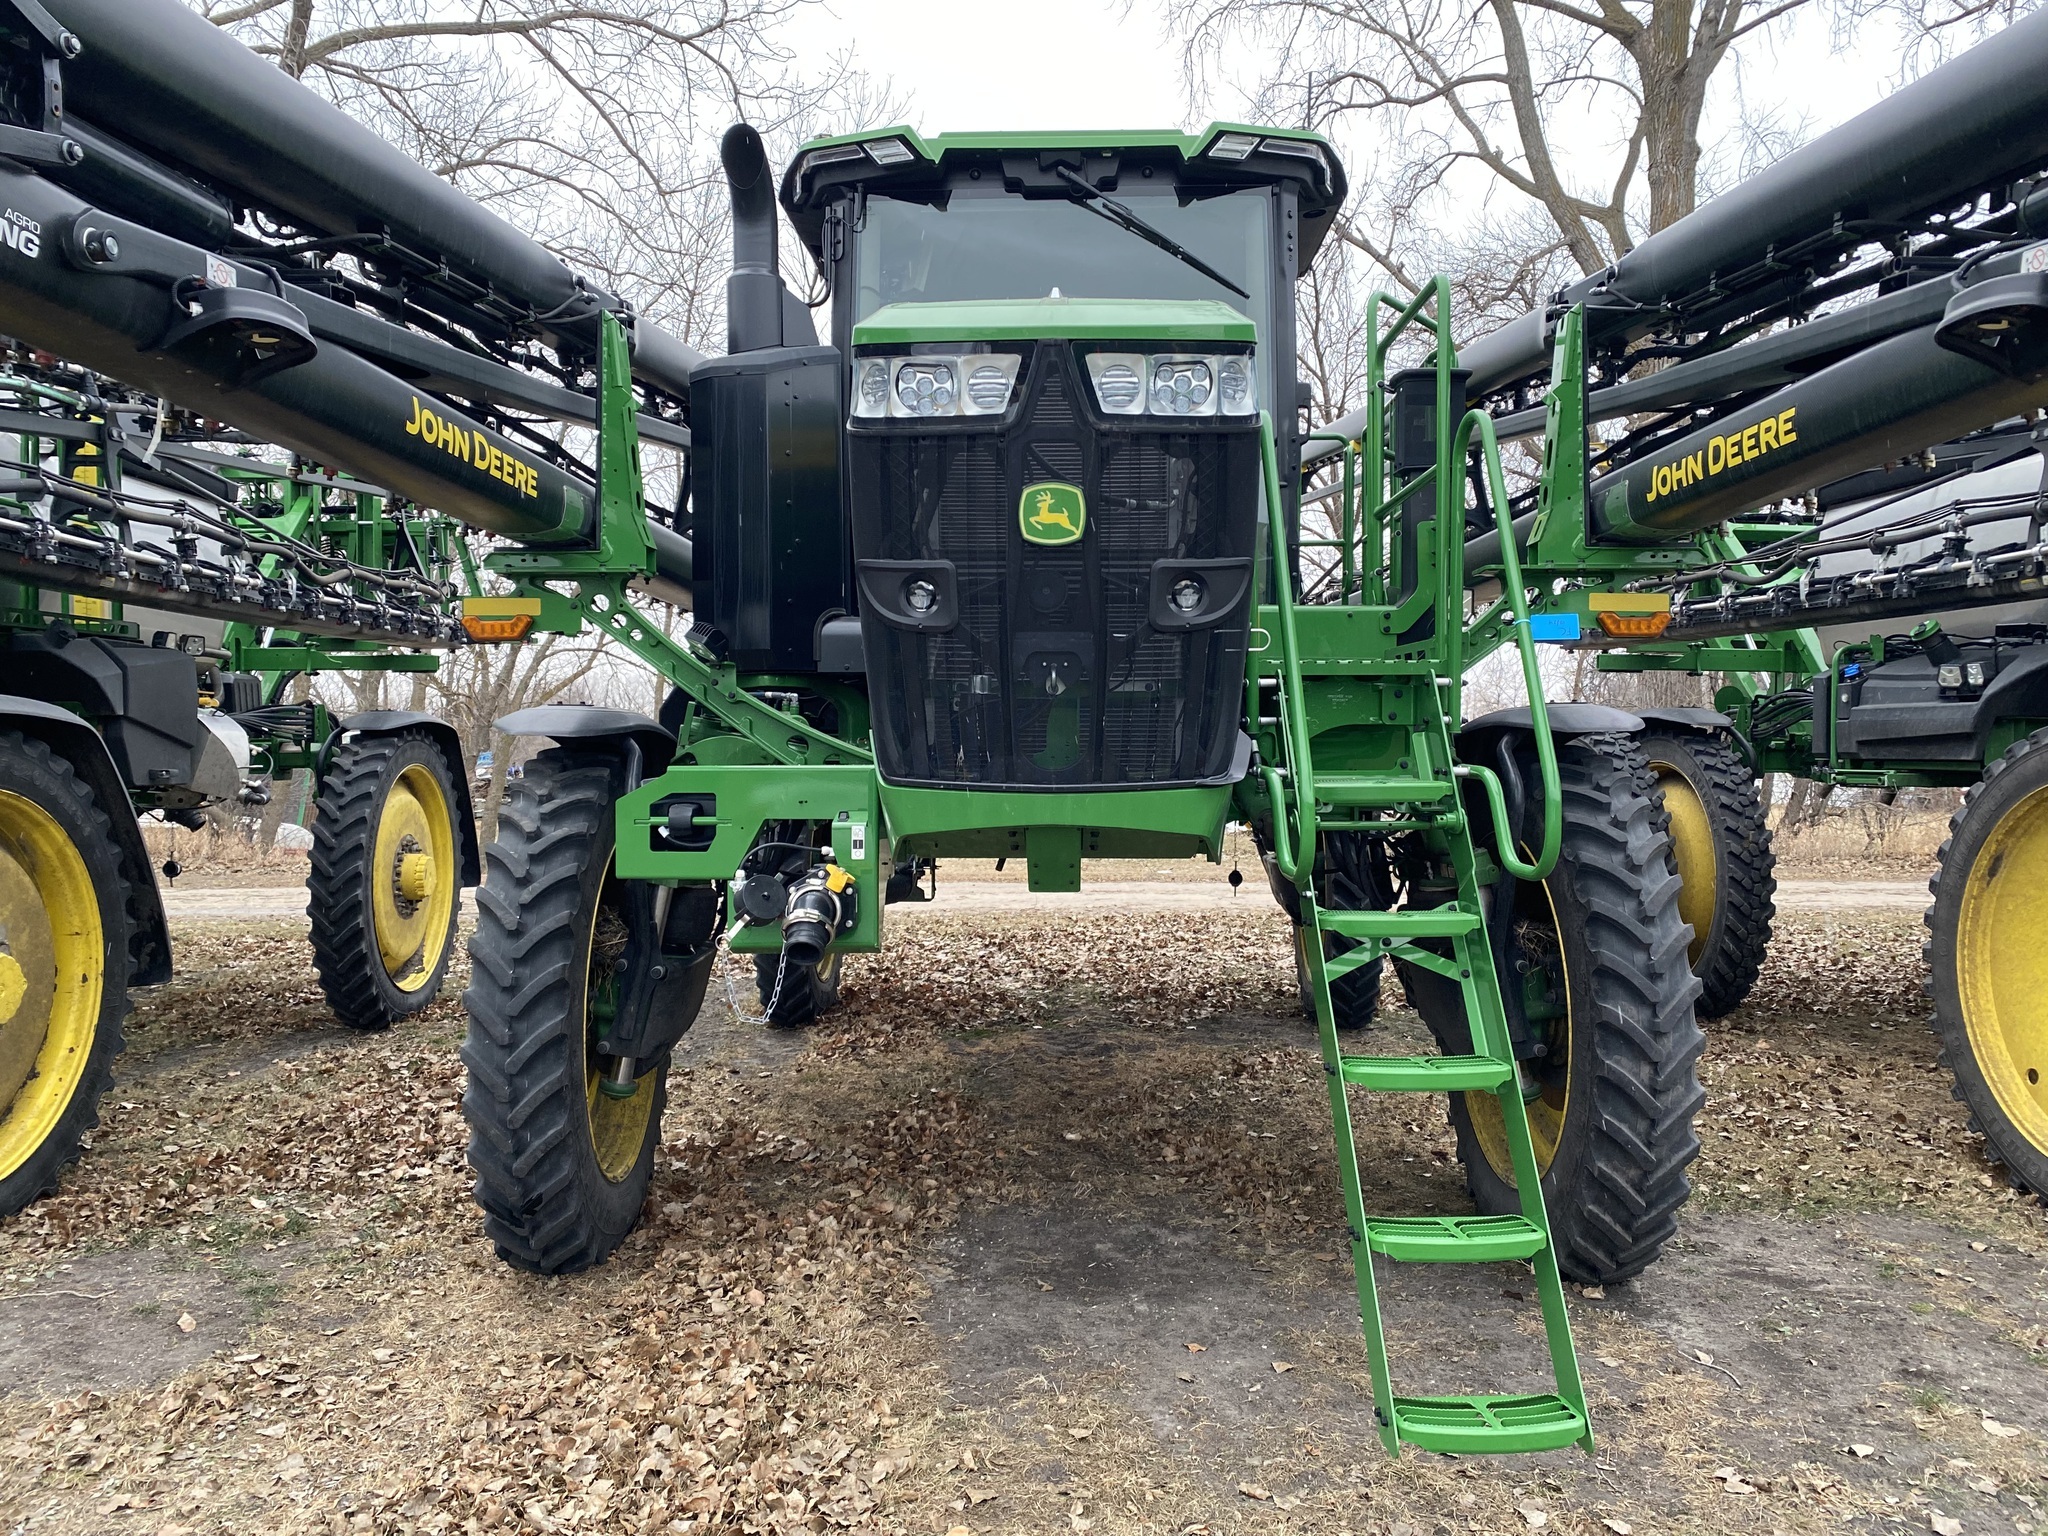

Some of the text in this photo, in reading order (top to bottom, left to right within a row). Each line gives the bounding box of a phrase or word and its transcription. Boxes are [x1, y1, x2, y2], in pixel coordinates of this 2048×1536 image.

[4, 207, 41, 235] AGRO
[405, 395, 539, 499] JOHN DEERE
[1645, 406, 1798, 503] JOHN DEERE
